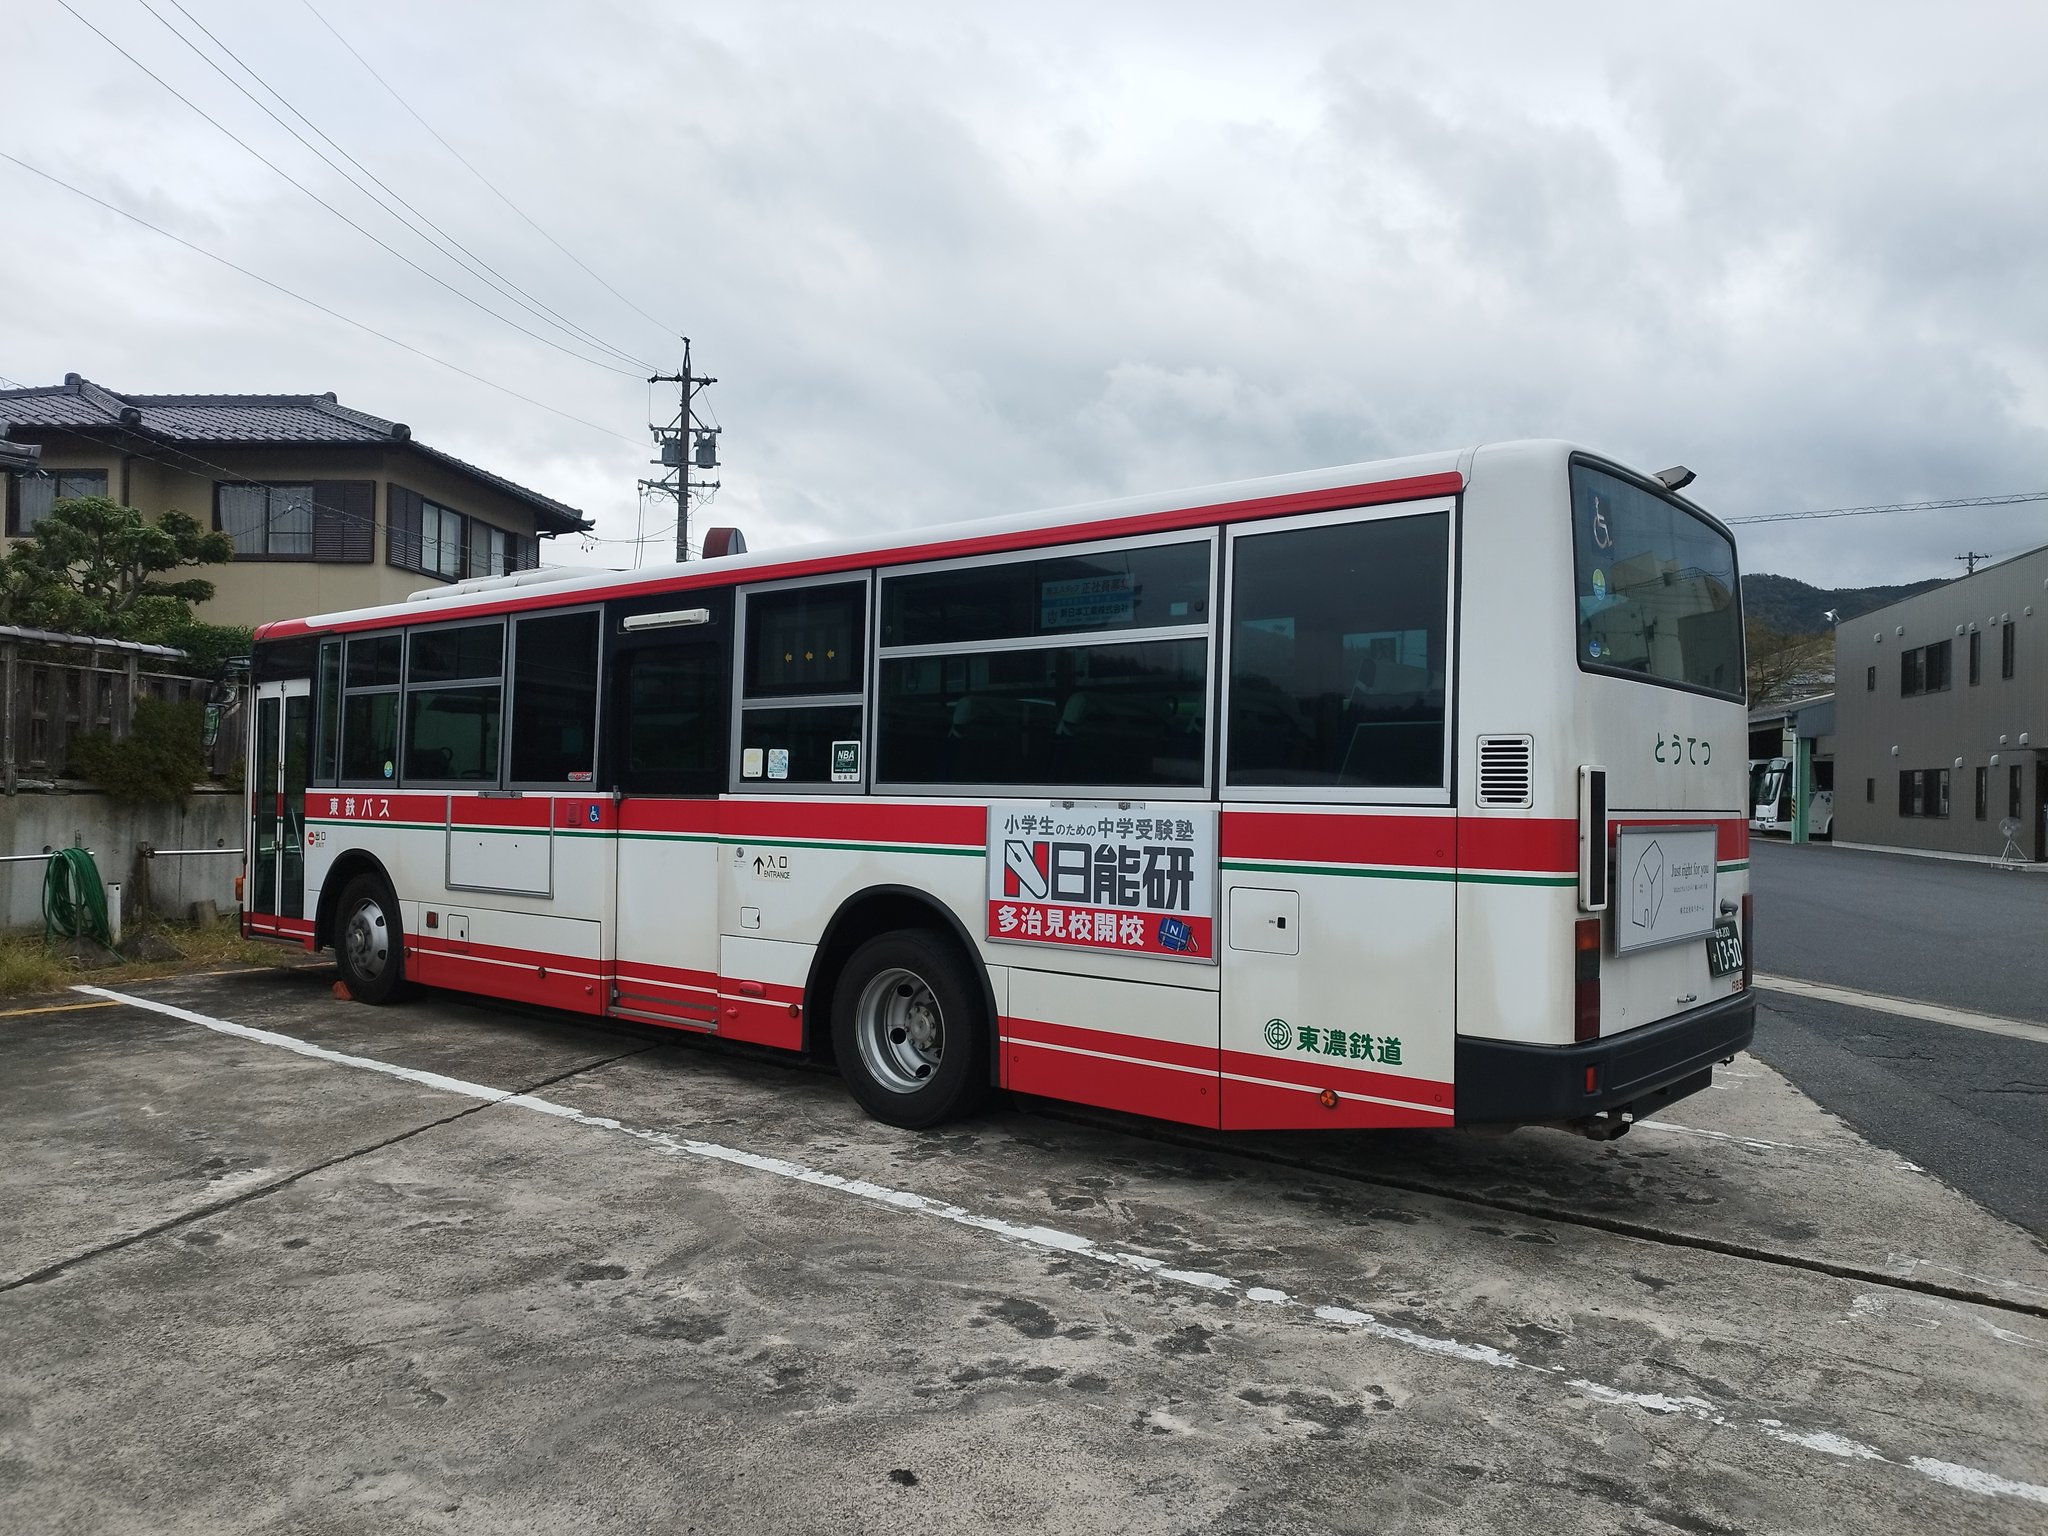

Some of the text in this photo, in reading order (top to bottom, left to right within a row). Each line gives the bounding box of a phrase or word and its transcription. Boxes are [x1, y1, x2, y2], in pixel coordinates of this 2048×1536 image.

[837, 750, 855, 760] NBA
[1654, 732, 1711, 765] とうてつ
[329, 797, 390, 818] 東鉄バス
[1004, 814, 1195, 842] 小学生のための中学受験塾
[767, 855, 788, 868] 入口
[764, 870, 790, 879] ENTRANCE
[1671, 863, 1681, 877] Just
[1682, 862, 1692, 879] right
[1701, 864, 1709, 877] you
[997, 904, 1145, 947] 多治見校開校
[1169, 924, 1180, 936] N
[1732, 978, 1744, 992] ABS
[1296, 1025, 1403, 1066] 東濃鉄道
